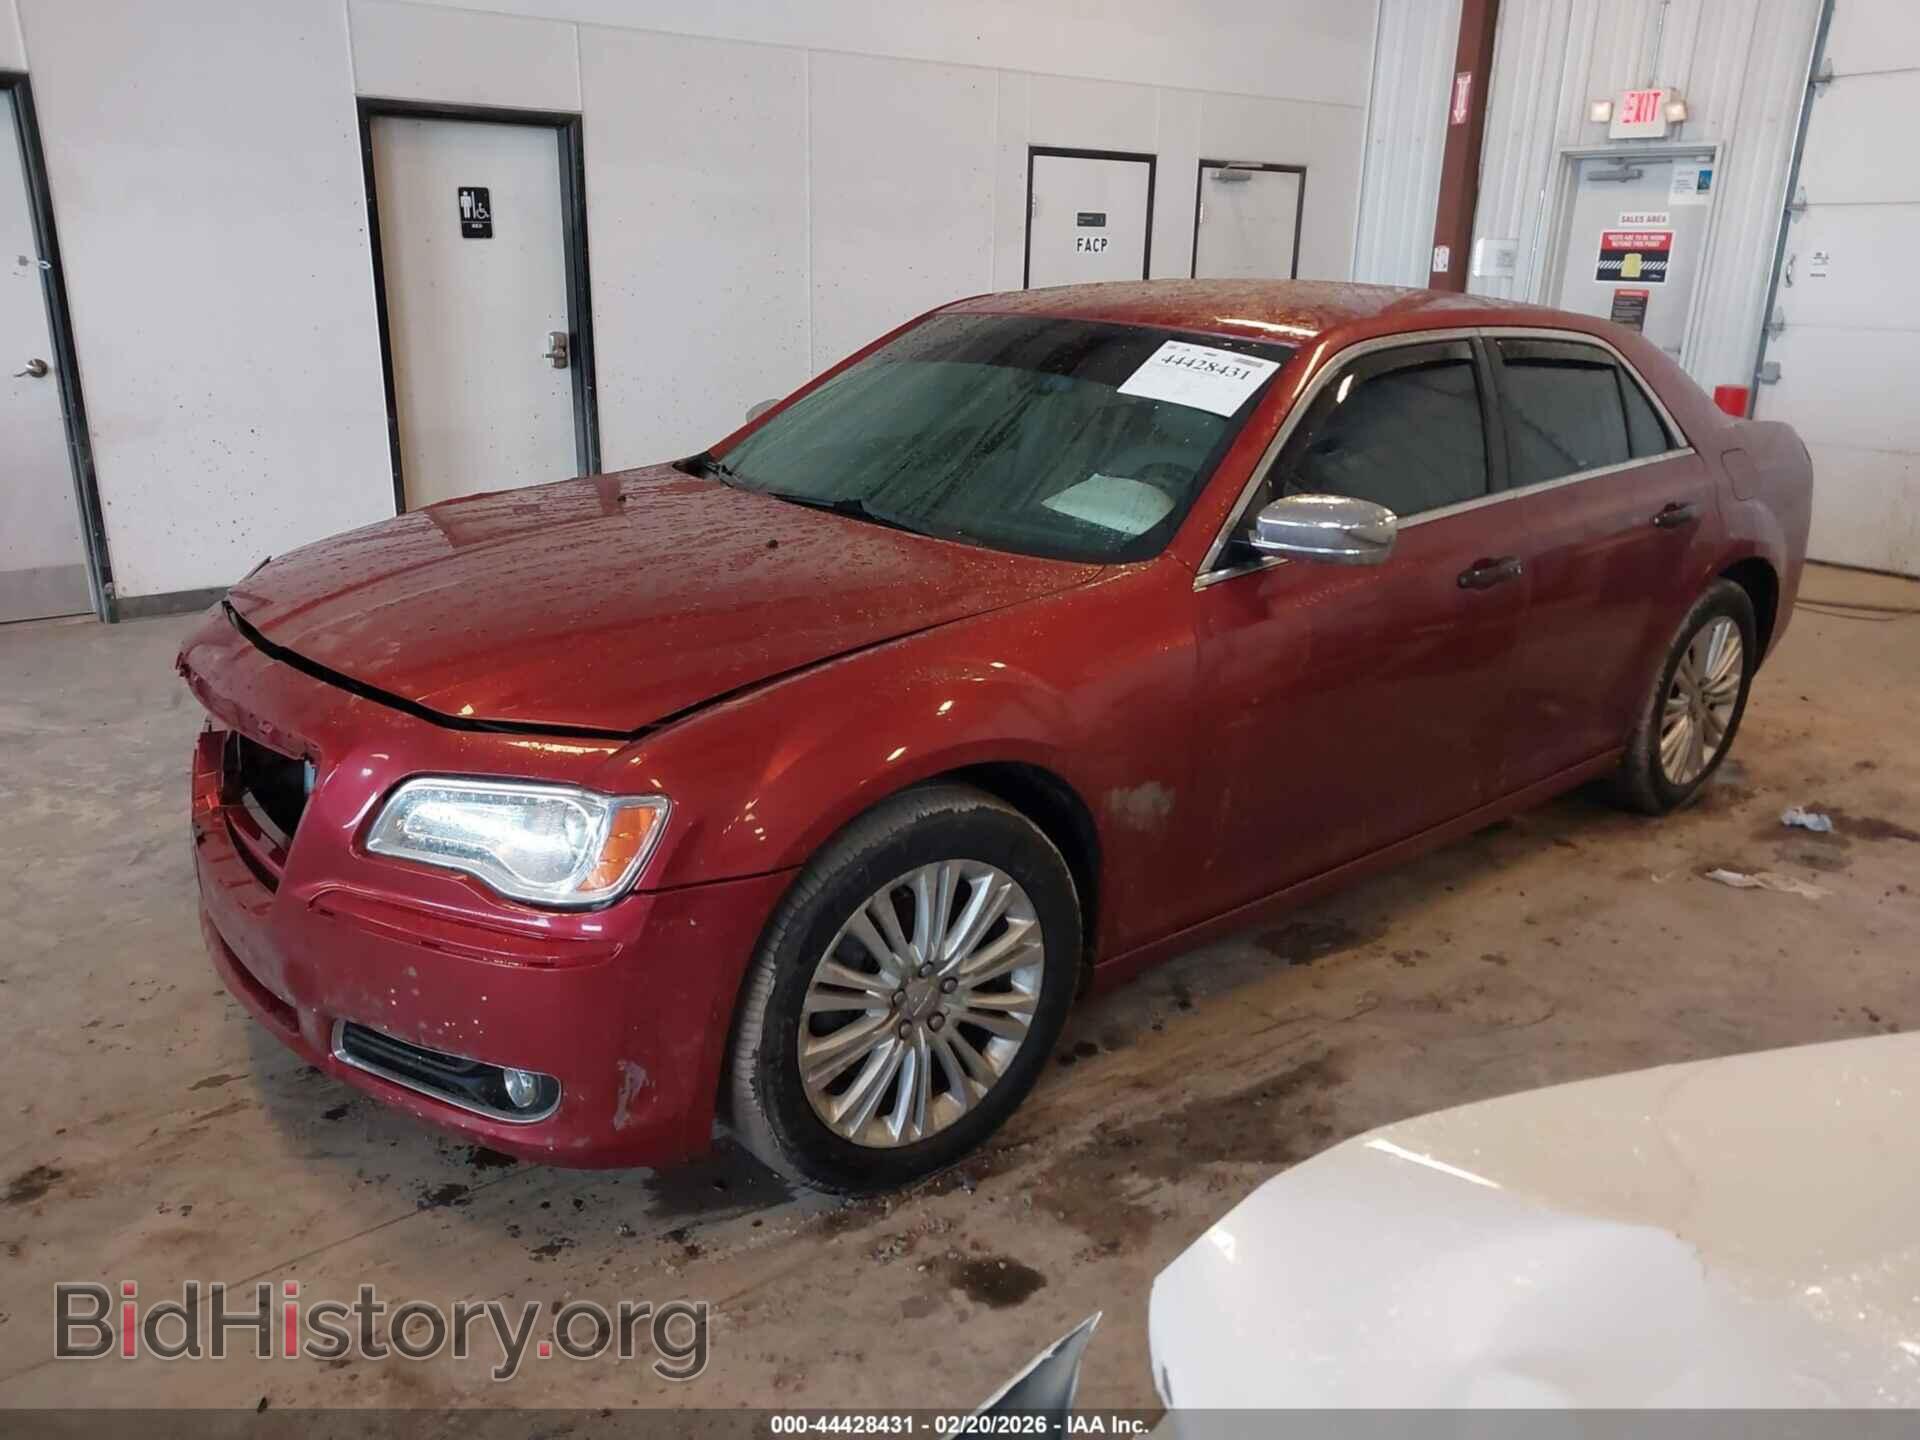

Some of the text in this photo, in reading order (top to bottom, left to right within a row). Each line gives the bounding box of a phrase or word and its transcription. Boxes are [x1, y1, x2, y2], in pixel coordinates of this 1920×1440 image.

[1622, 91, 1662, 123] EXIT
[1077, 237, 1108, 252] FACP
[1161, 354, 1251, 380] 44428431
